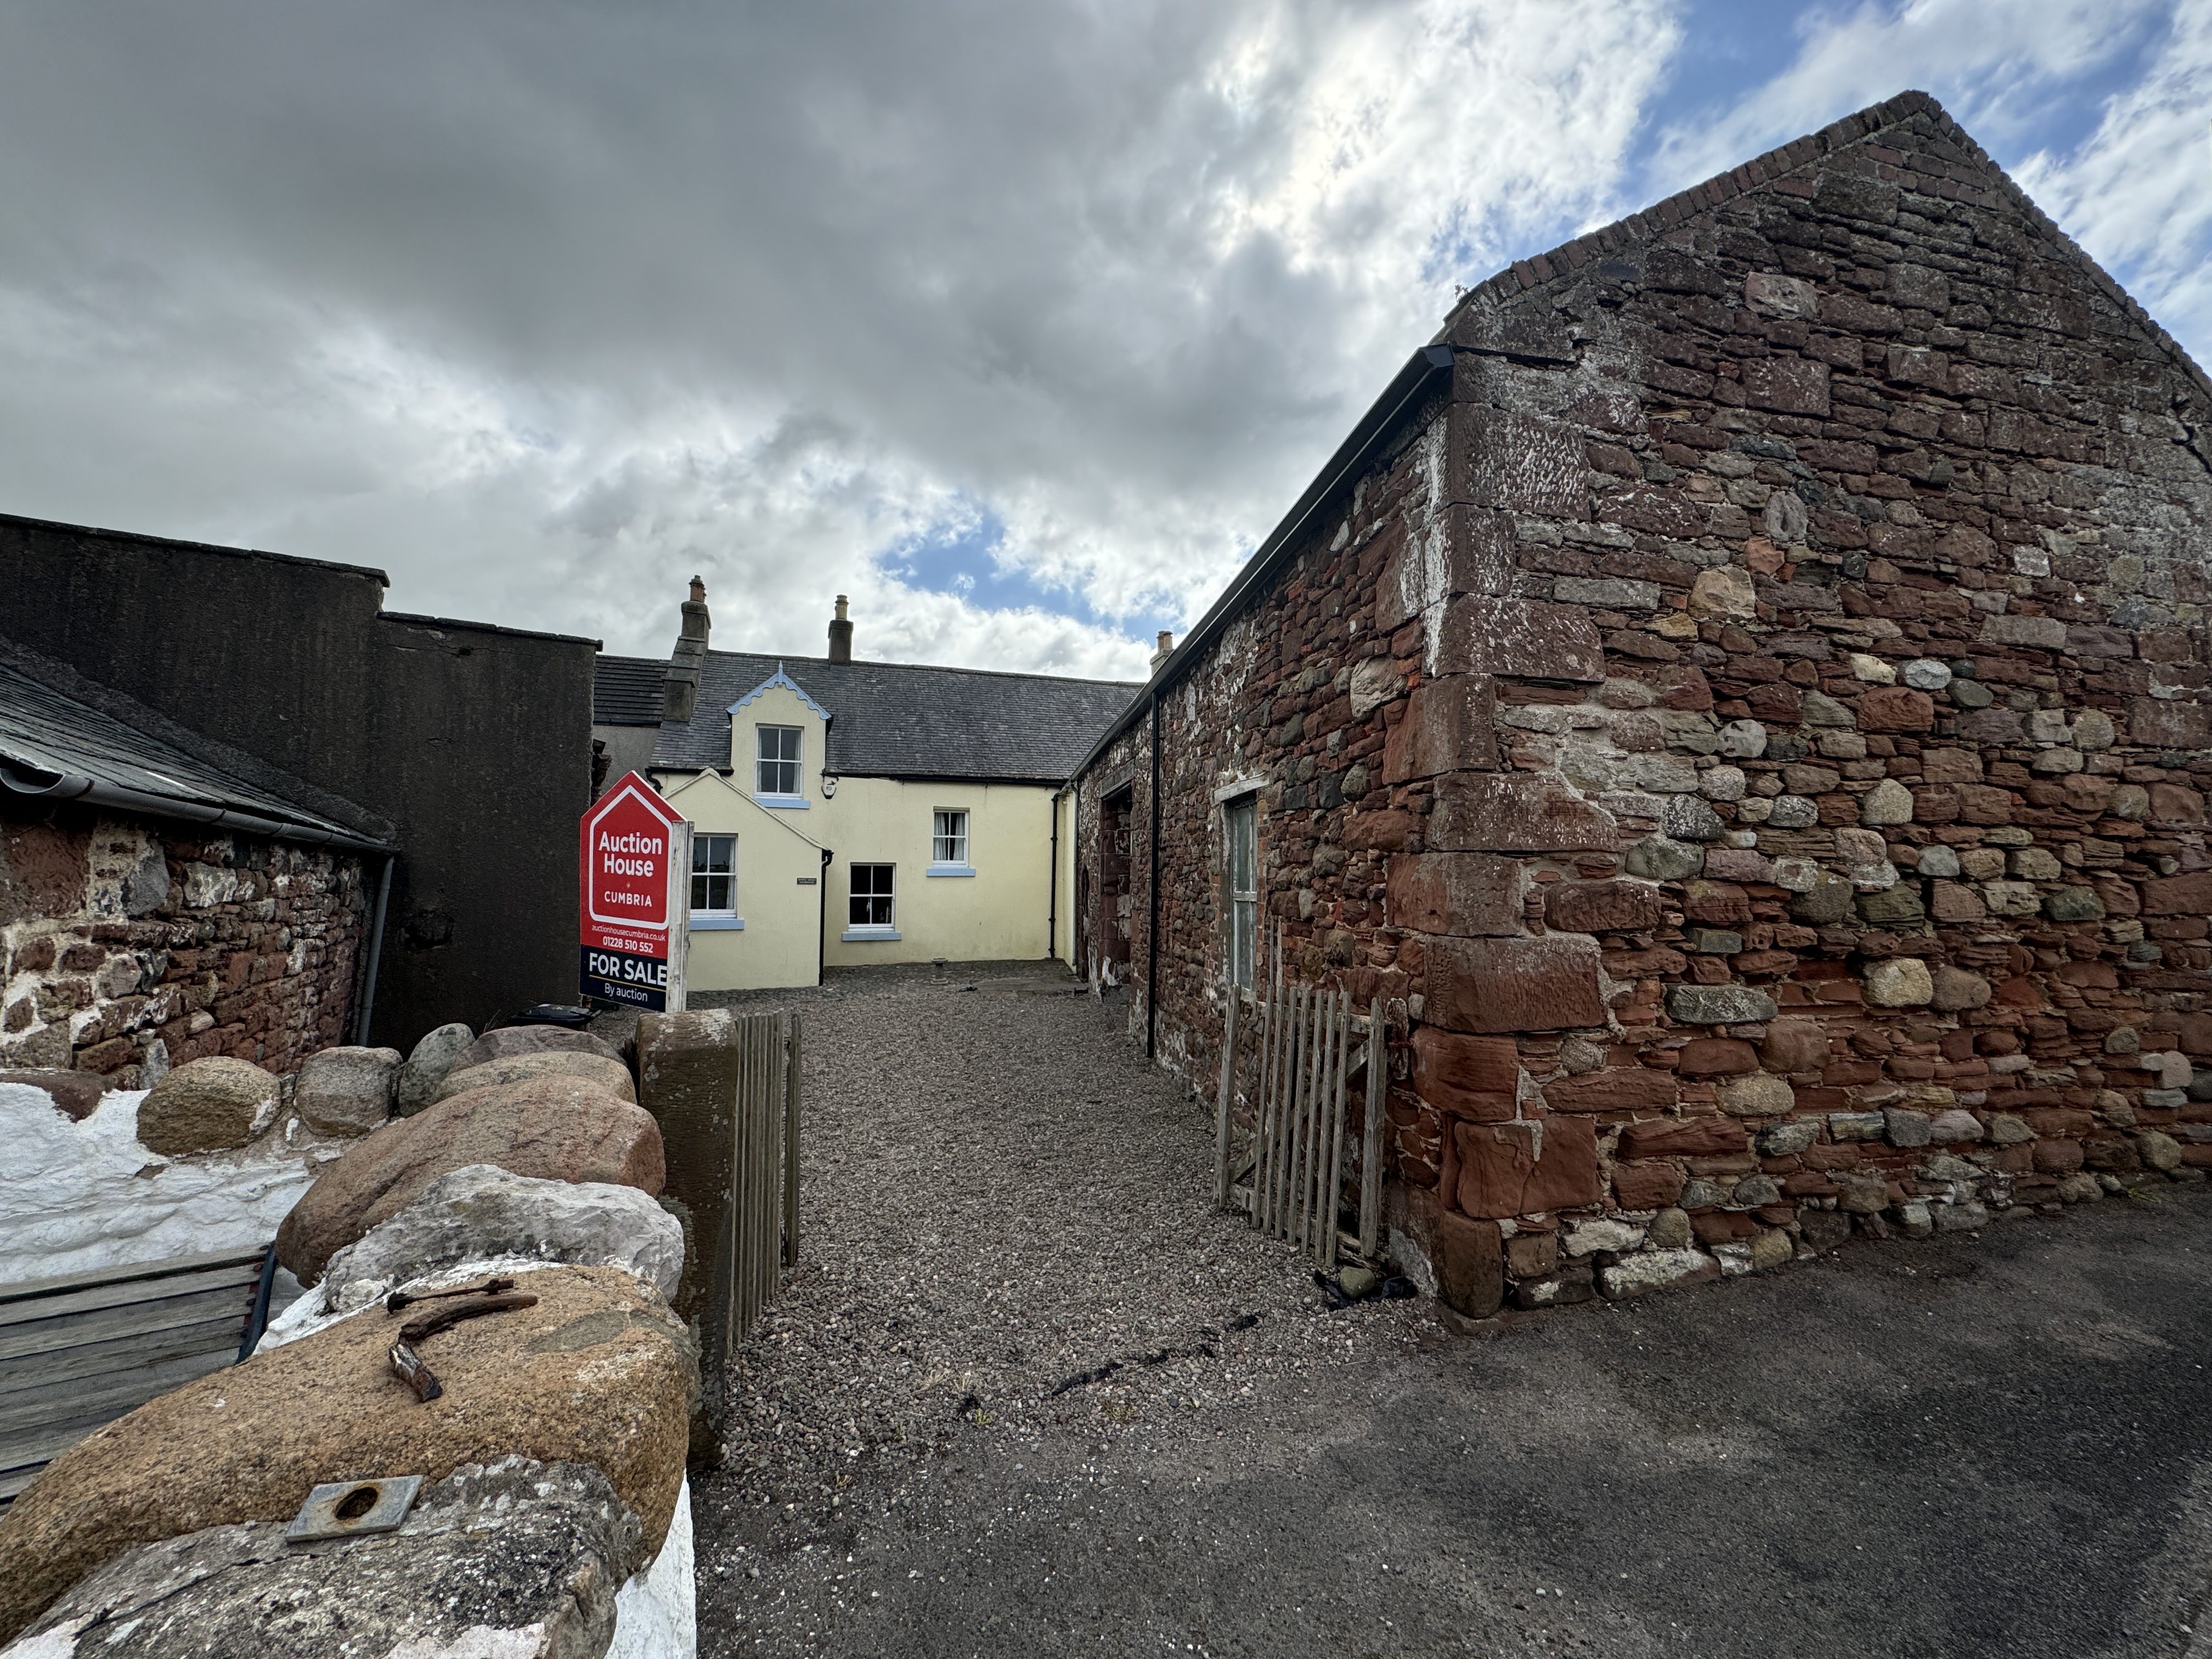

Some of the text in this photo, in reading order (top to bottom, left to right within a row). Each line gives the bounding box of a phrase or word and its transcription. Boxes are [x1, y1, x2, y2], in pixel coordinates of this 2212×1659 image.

[599, 831, 662, 855] Auction
[604, 853, 654, 877] House
[604, 890, 652, 907] CUMBRIA
[592, 925, 665, 941] auctionhousecumbria.co.uk
[603, 936, 653, 953] 01228 510 552
[589, 952, 668, 986] FOR SALE
[605, 983, 647, 1002] By auction
